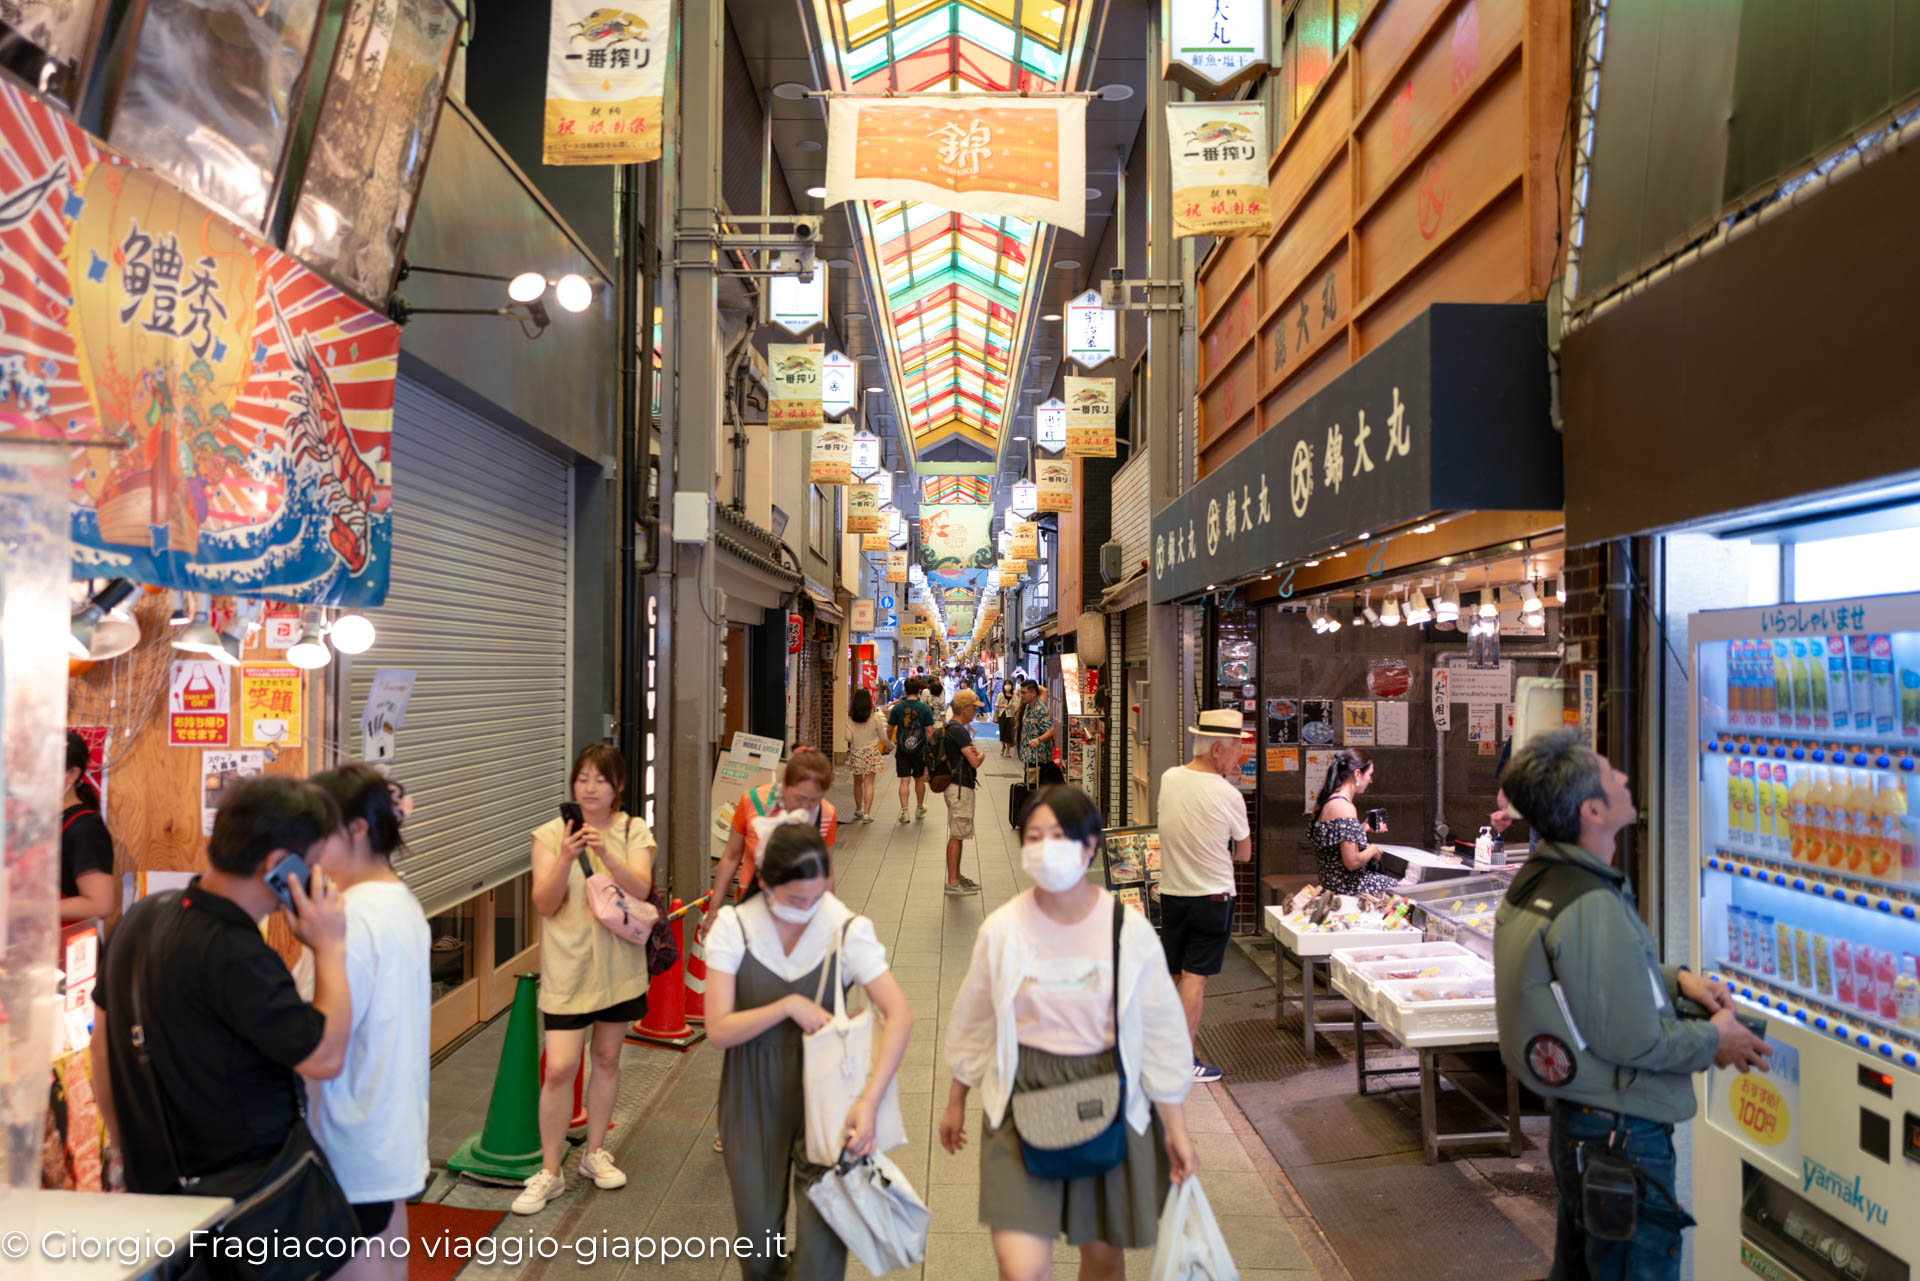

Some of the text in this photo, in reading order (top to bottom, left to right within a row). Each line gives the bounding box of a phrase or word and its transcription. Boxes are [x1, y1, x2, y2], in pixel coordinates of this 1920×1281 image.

[565, 48, 650, 69] 一番搾り
[925, 118, 992, 174] 錦
[1184, 146, 1255, 161] 一番搾り
[776, 374, 816, 384] 一番搾り
[1072, 405, 1109, 414] 一番搾り
[1324, 386, 1411, 495] 錦大丸
[1225, 473, 1271, 542] 錦大丸
[1168, 519, 1196, 571] 錦大丸
[1761, 605, 1865, 633] いらっしゃいませ
[251, 679, 293, 687] マスクの下は
[248, 687, 294, 712] 笑顔
[174, 716, 225, 728] お持ち帰り
[177, 729, 223, 741] できます。
[1739, 1097, 1777, 1138] 100円
